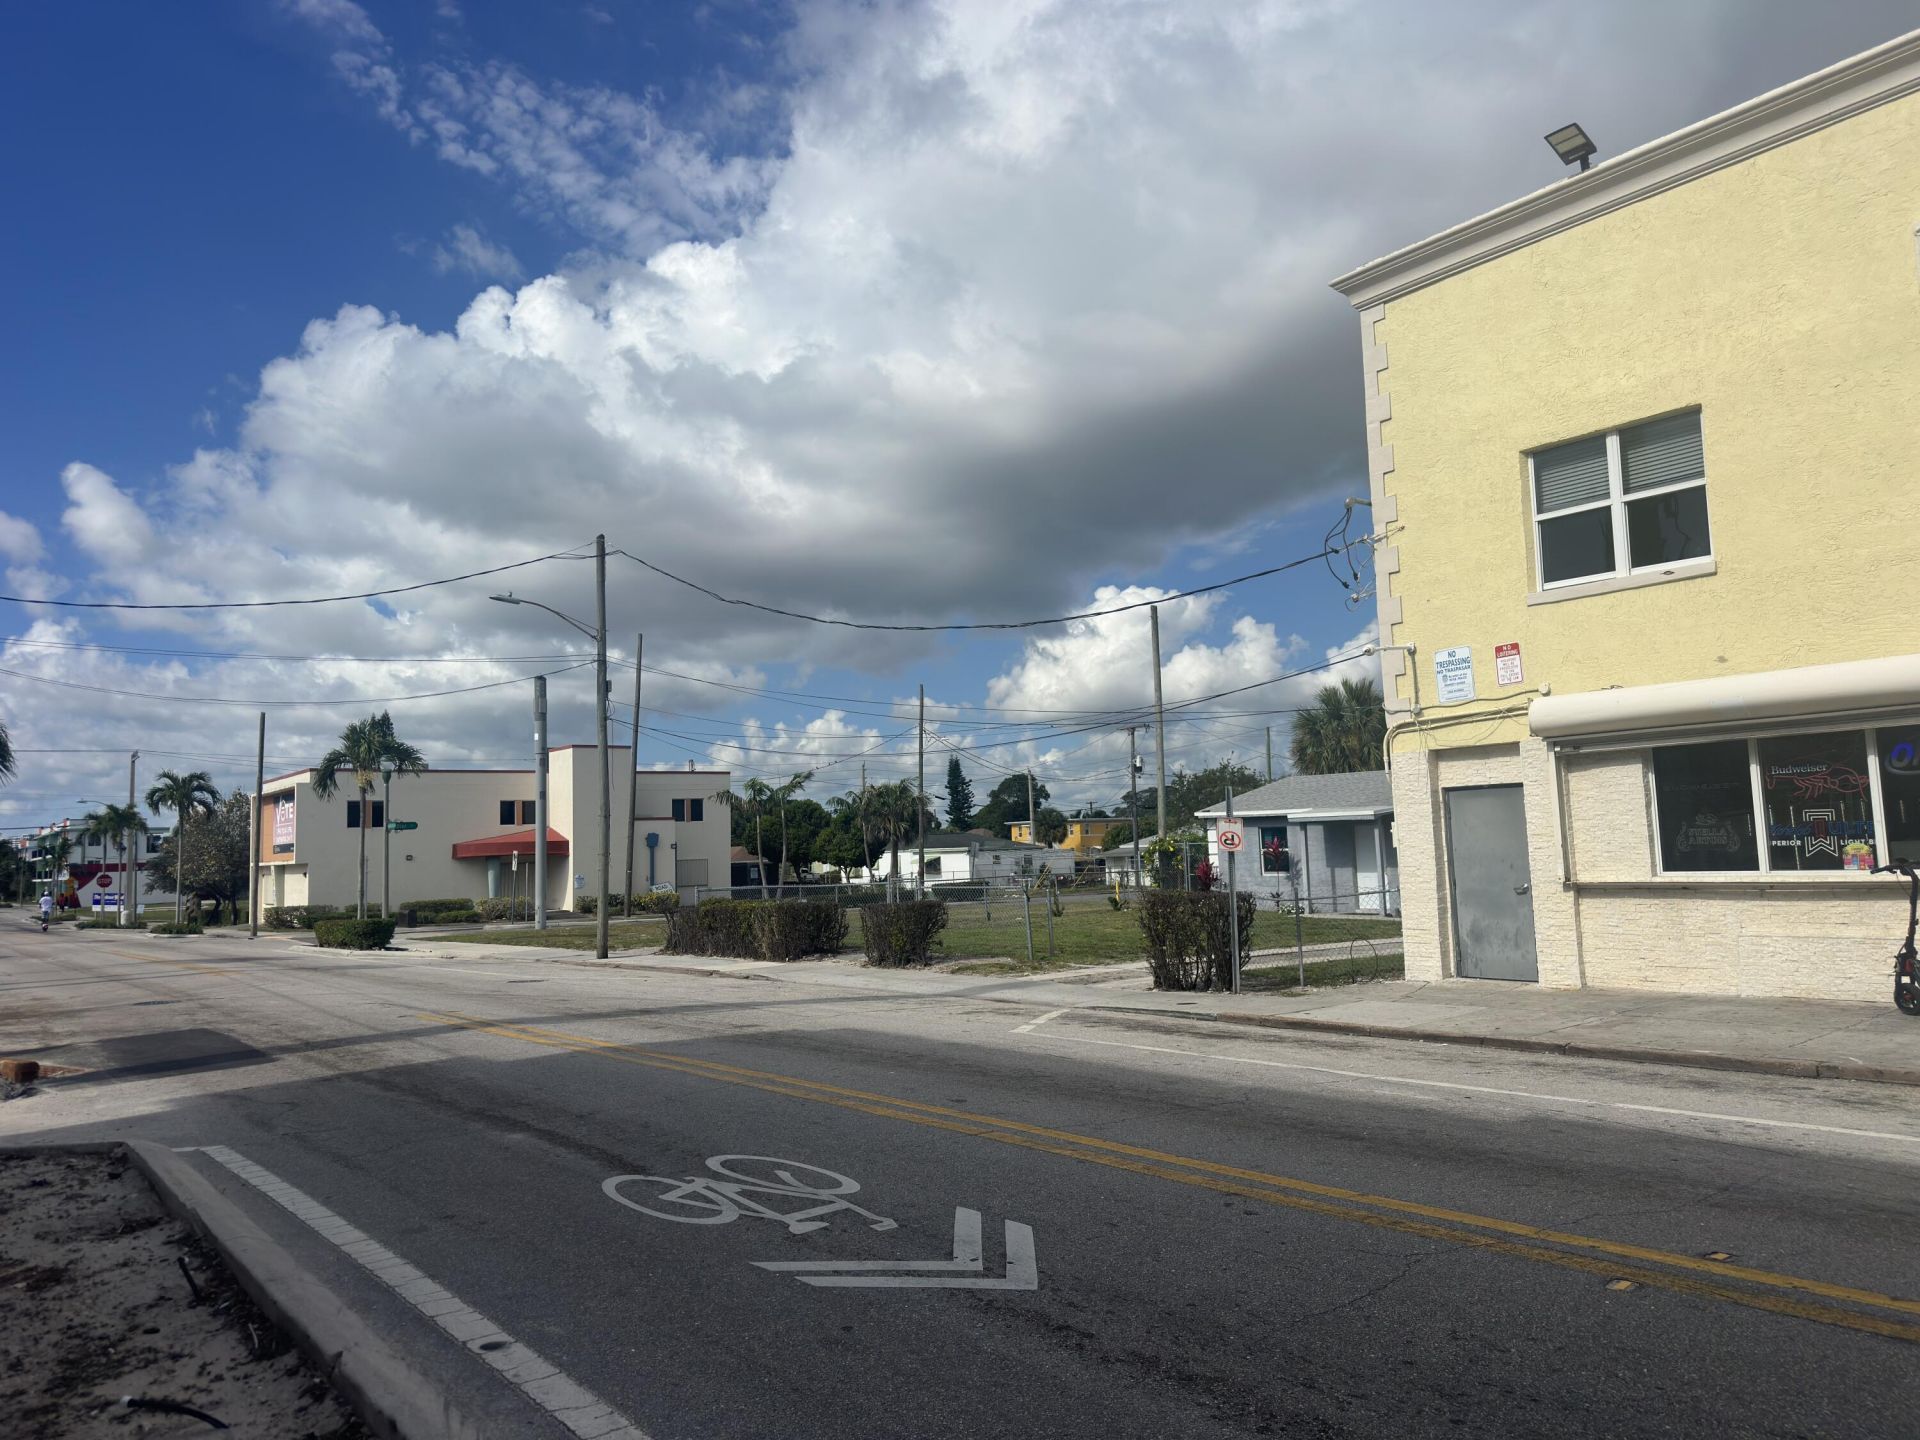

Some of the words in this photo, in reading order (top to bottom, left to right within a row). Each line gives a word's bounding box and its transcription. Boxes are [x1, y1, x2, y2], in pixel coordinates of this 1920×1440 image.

[1447, 650, 1457, 659] NO
[1436, 657, 1471, 669] TRESPASSING
[1770, 763, 1828, 775] Budweiser
[276, 799, 294, 825] VOTE
[1688, 828, 1728, 836] STELLA
[1840, 838, 1867, 846] LIGHT
